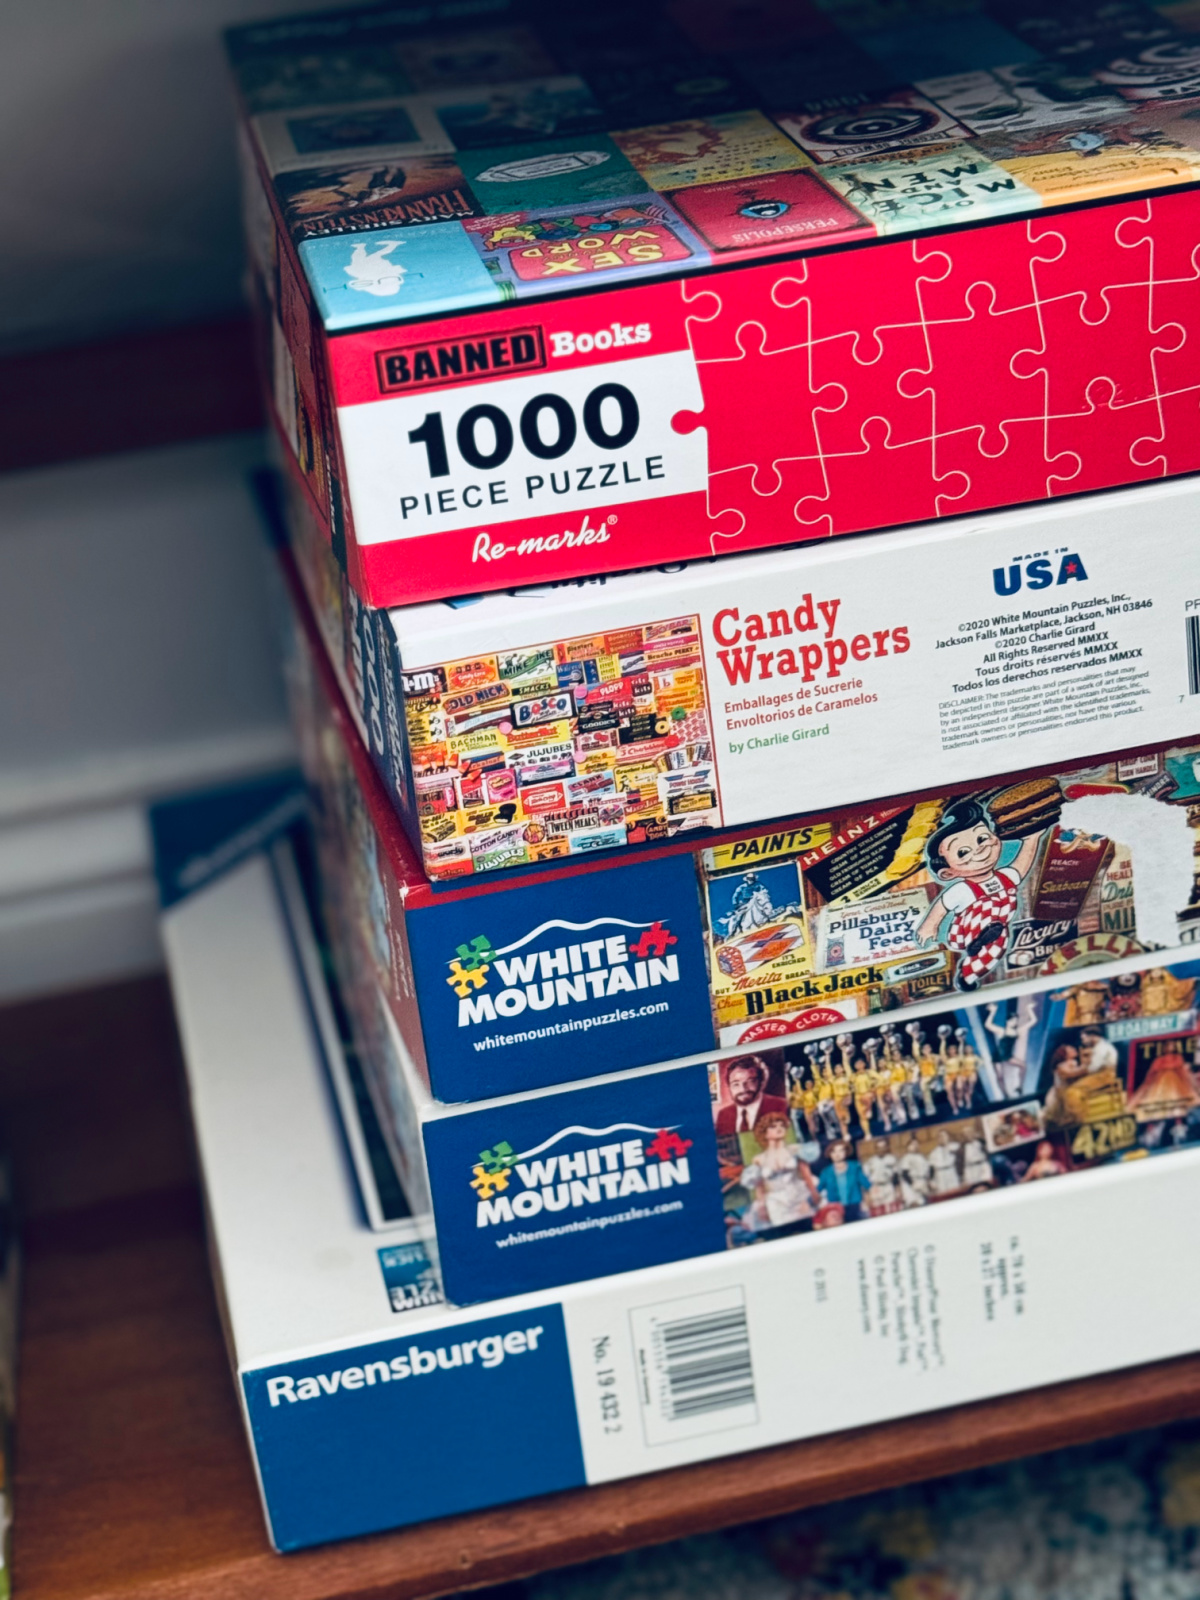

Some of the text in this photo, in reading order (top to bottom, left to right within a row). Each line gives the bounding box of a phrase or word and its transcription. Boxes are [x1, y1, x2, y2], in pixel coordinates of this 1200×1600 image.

[861, 164, 979, 193] MEN
[872, 178, 1016, 213] MICE
[521, 230, 660, 258] WORD
[731, 217, 840, 243] PERSEPOLIS
[541, 244, 664, 276] SEX
[384, 323, 652, 386] BANNED Books
[407, 382, 640, 479] 1000
[400, 455, 666, 520] PIECE PUZZLE
[1012, 547, 1069, 563] MADE IN
[992, 553, 1089, 597] USA
[712, 593, 841, 647] Candy
[935, 598, 1153, 649] Jackson Falls Marketplace, Jackson, NH 03846
[991, 614, 1020, 626] White
[1022, 604, 1069, 620] Mountain
[1071, 597, 1110, 610] Puzzles,
[983, 631, 1109, 664] All Rights Reserved MMXX
[1028, 629, 1063, 643] Charlie
[1065, 621, 1095, 636] Girard
[503, 661, 528, 676] MIKE
[716, 626, 911, 686] Wrappers
[952, 648, 1143, 693] Todos los derechos reservados MMXX
[975, 641, 1118, 677] Tous droits réservés MMXX
[449, 683, 504, 710] OLD NICK
[519, 682, 551, 695] SMACKS
[600, 681, 624, 697] PLOPP
[724, 678, 863, 714] Emballages de Sucrerie
[950, 703, 982, 716] depicted
[992, 699, 1006, 708] this
[1076, 683, 1094, 691] work
[1116, 671, 1150, 684] designed
[985, 692, 999, 700] The
[1000, 683, 1040, 697] trademarks
[1042, 681, 1056, 689] and
[1104, 669, 1119, 677] that
[1120, 666, 1136, 675] may
[519, 696, 568, 723] BOSCO
[726, 692, 878, 731] Envoltorios de Caramelos
[941, 730, 979, 743] trademark
[980, 725, 1006, 735] owners
[1078, 707, 1096, 716] have
[1097, 704, 1109, 712] the
[1111, 700, 1136, 709] various
[948, 725, 961, 733] not
[962, 717, 999, 731] associated
[1043, 706, 1059, 714] with
[1060, 703, 1073, 711] the
[961, 689, 1100, 722] independent White Mountain
[729, 723, 830, 754] by Charlie Girard
[942, 738, 980, 751] trademark
[981, 733, 1007, 743] owners
[1064, 715, 1098, 727] endorsed
[1100, 712, 1112, 720] this
[527, 742, 572, 758] JUJUBES
[470, 838, 499, 853] COTTON
[731, 828, 814, 860] PAINTS
[803, 814, 880, 866] HEINZ
[476, 847, 525, 871] JUJUBES
[829, 860, 848, 873] CREAM
[829, 872, 842, 881] OLD
[830, 874, 851, 888] CREAM
[830, 881, 852, 895] CREAM
[984, 879, 998, 888] BIG
[987, 884, 1001, 893] BOY
[1040, 880, 1090, 894] Sunbeam
[829, 905, 920, 934] Pillsbury's
[859, 920, 915, 939] Dairy
[1013, 919, 1073, 950] Luxury
[868, 929, 914, 950] Feed
[493, 934, 629, 986] WHITE
[772, 957, 806, 968] ENRICHED
[782, 953, 795, 962] IT'S
[458, 954, 680, 1028] MOUNTAIN
[715, 970, 811, 995] BUY Merita BREAD
[743, 967, 884, 1016] Black Jack
[909, 973, 950, 992] TOILET
[473, 1001, 669, 1052] whitemountainpuzzles.com
[741, 1012, 839, 1045] MASTER CLOTH
[1071, 1115, 1136, 1160] 42ND
[515, 1138, 645, 1189] WHITE
[476, 1157, 691, 1228] MOUNTAIN
[496, 1200, 684, 1249] whitemountainpuzzles.com
[266, 1325, 544, 1407] Ravensburger
[592, 1335, 623, 1435] No. 19 432 2
